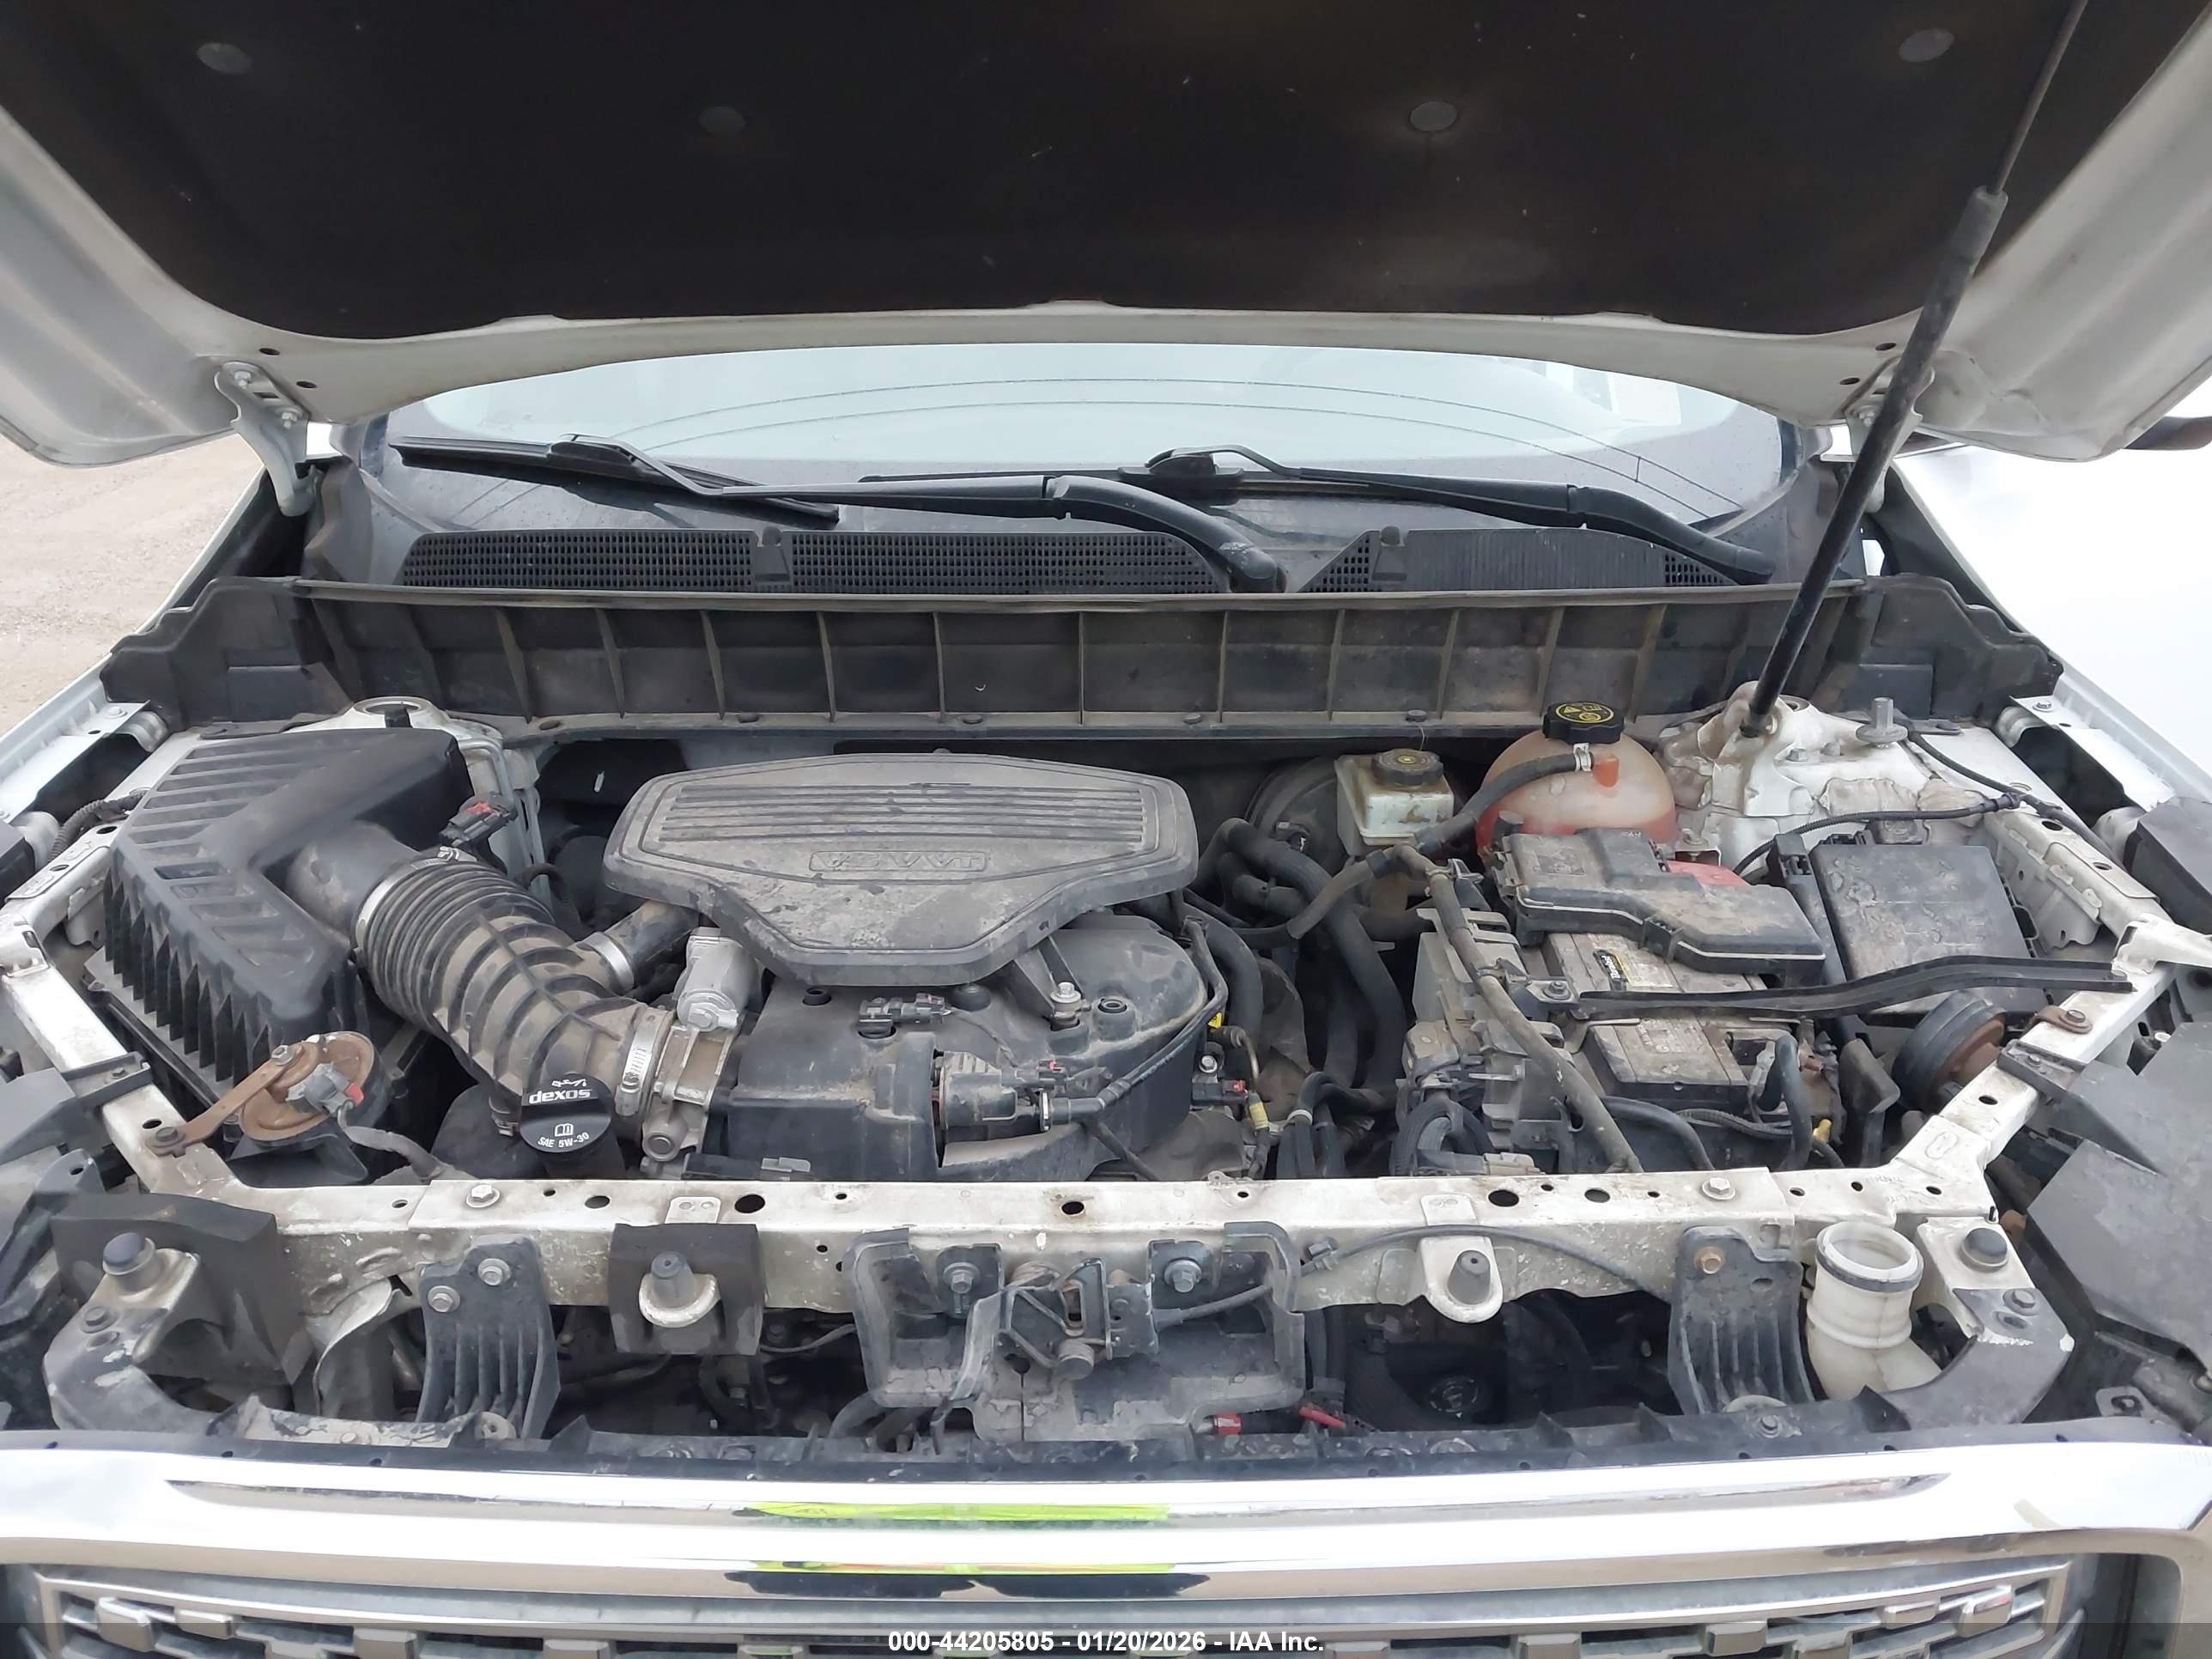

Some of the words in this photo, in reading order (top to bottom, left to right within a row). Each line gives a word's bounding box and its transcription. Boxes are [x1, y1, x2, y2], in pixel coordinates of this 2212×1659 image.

[528, 1088, 593, 1104] dexos
[538, 1136, 556, 1148] SAE
[558, 1132, 590, 1148] 5W-30
